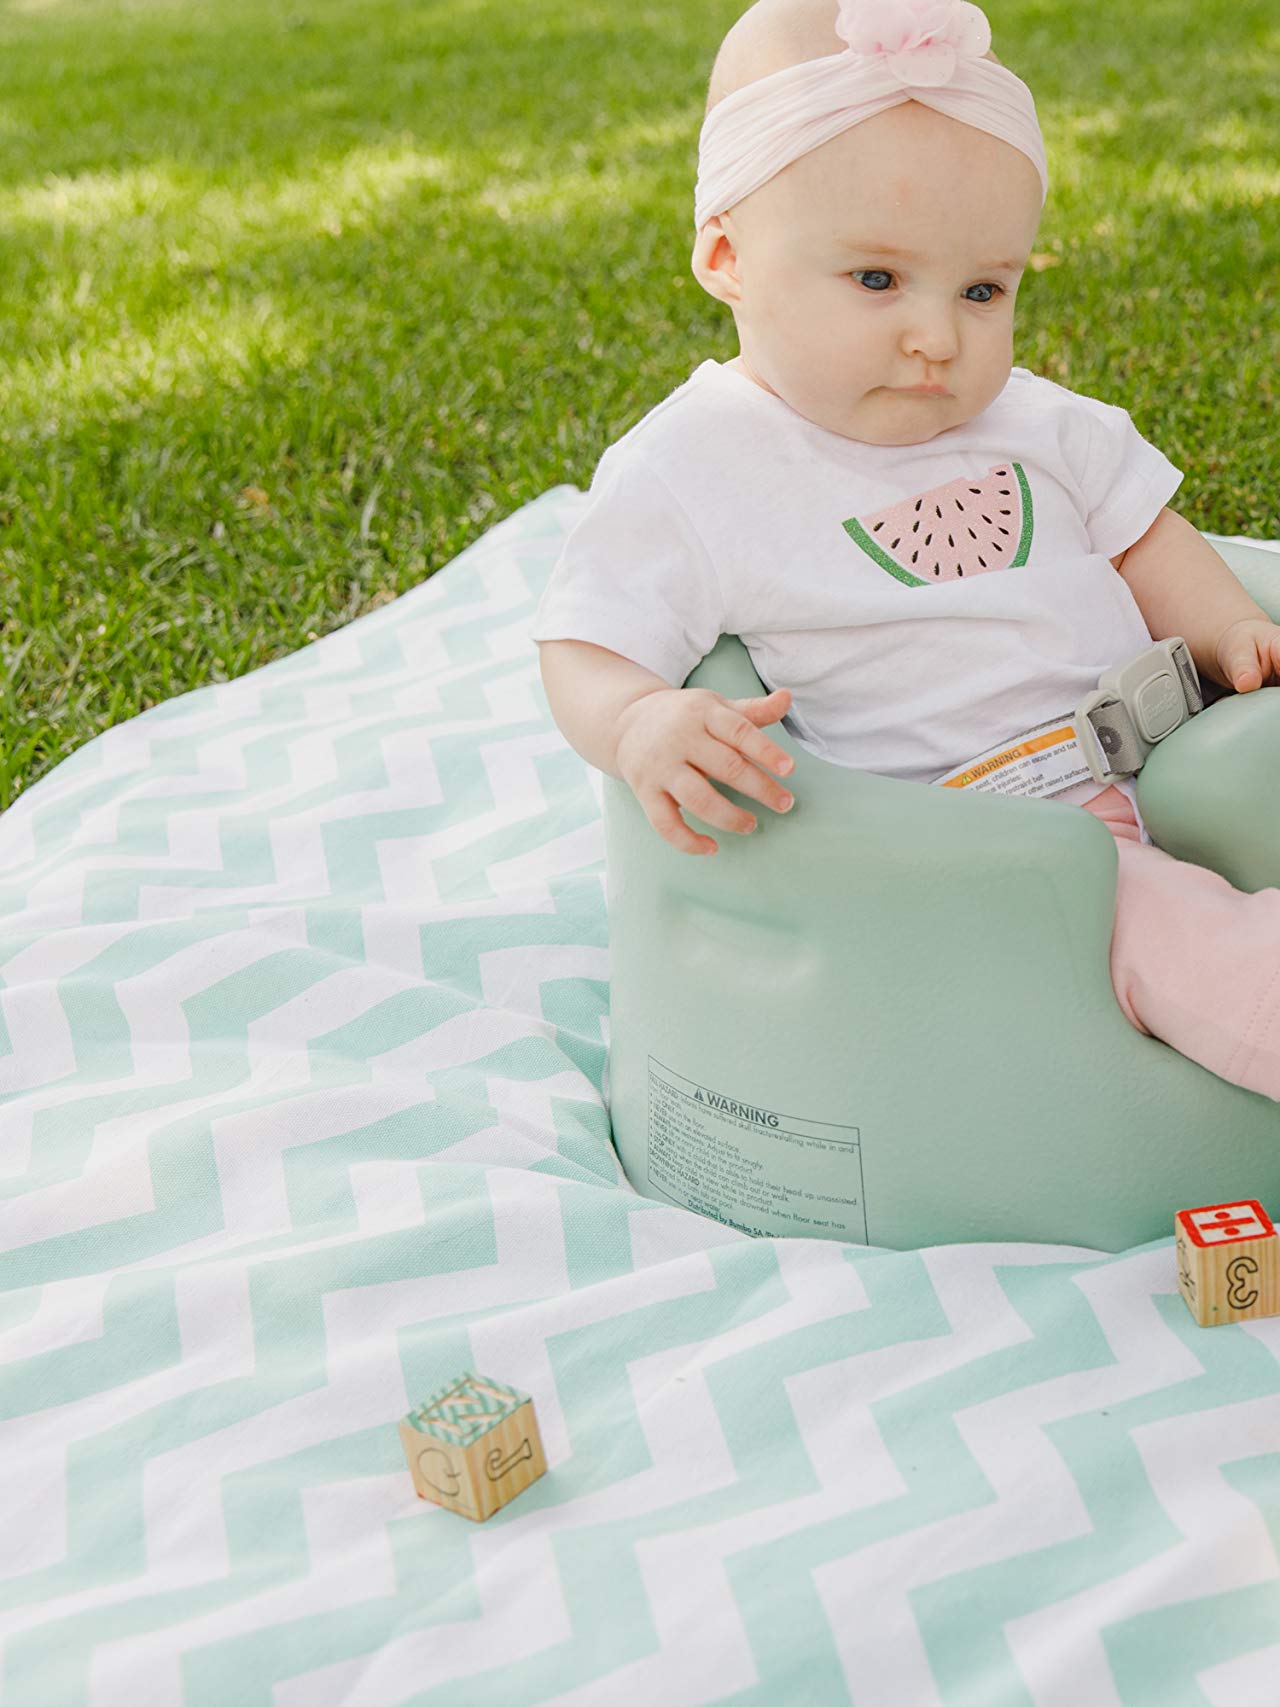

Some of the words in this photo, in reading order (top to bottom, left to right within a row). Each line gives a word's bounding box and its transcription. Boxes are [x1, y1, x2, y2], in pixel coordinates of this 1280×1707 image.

[971, 749, 1022, 778] WARNING
[992, 766, 1018, 783] children
[1018, 760, 1031, 770] can
[1032, 752, 1052, 764] escape
[1054, 746, 1065, 755] and
[1064, 766, 1090, 780] surfaces
[706, 1091, 779, 1129] WARNING
[805, 1139, 827, 1151] while
[838, 1145, 854, 1154] and
[749, 1174, 764, 1187] hold
[782, 1184, 801, 1197] head
[803, 1191, 814, 1201] up
[749, 1183, 760, 1194] out
[739, 1196, 769, 1215] drowned
[771, 1206, 791, 1220] when
[792, 1212, 810, 1224] floor
[812, 1217, 829, 1228] seat
[831, 1220, 846, 1230] has
[753, 1227, 764, 1239] SA
[1226, 1255, 1259, 1310] 3
